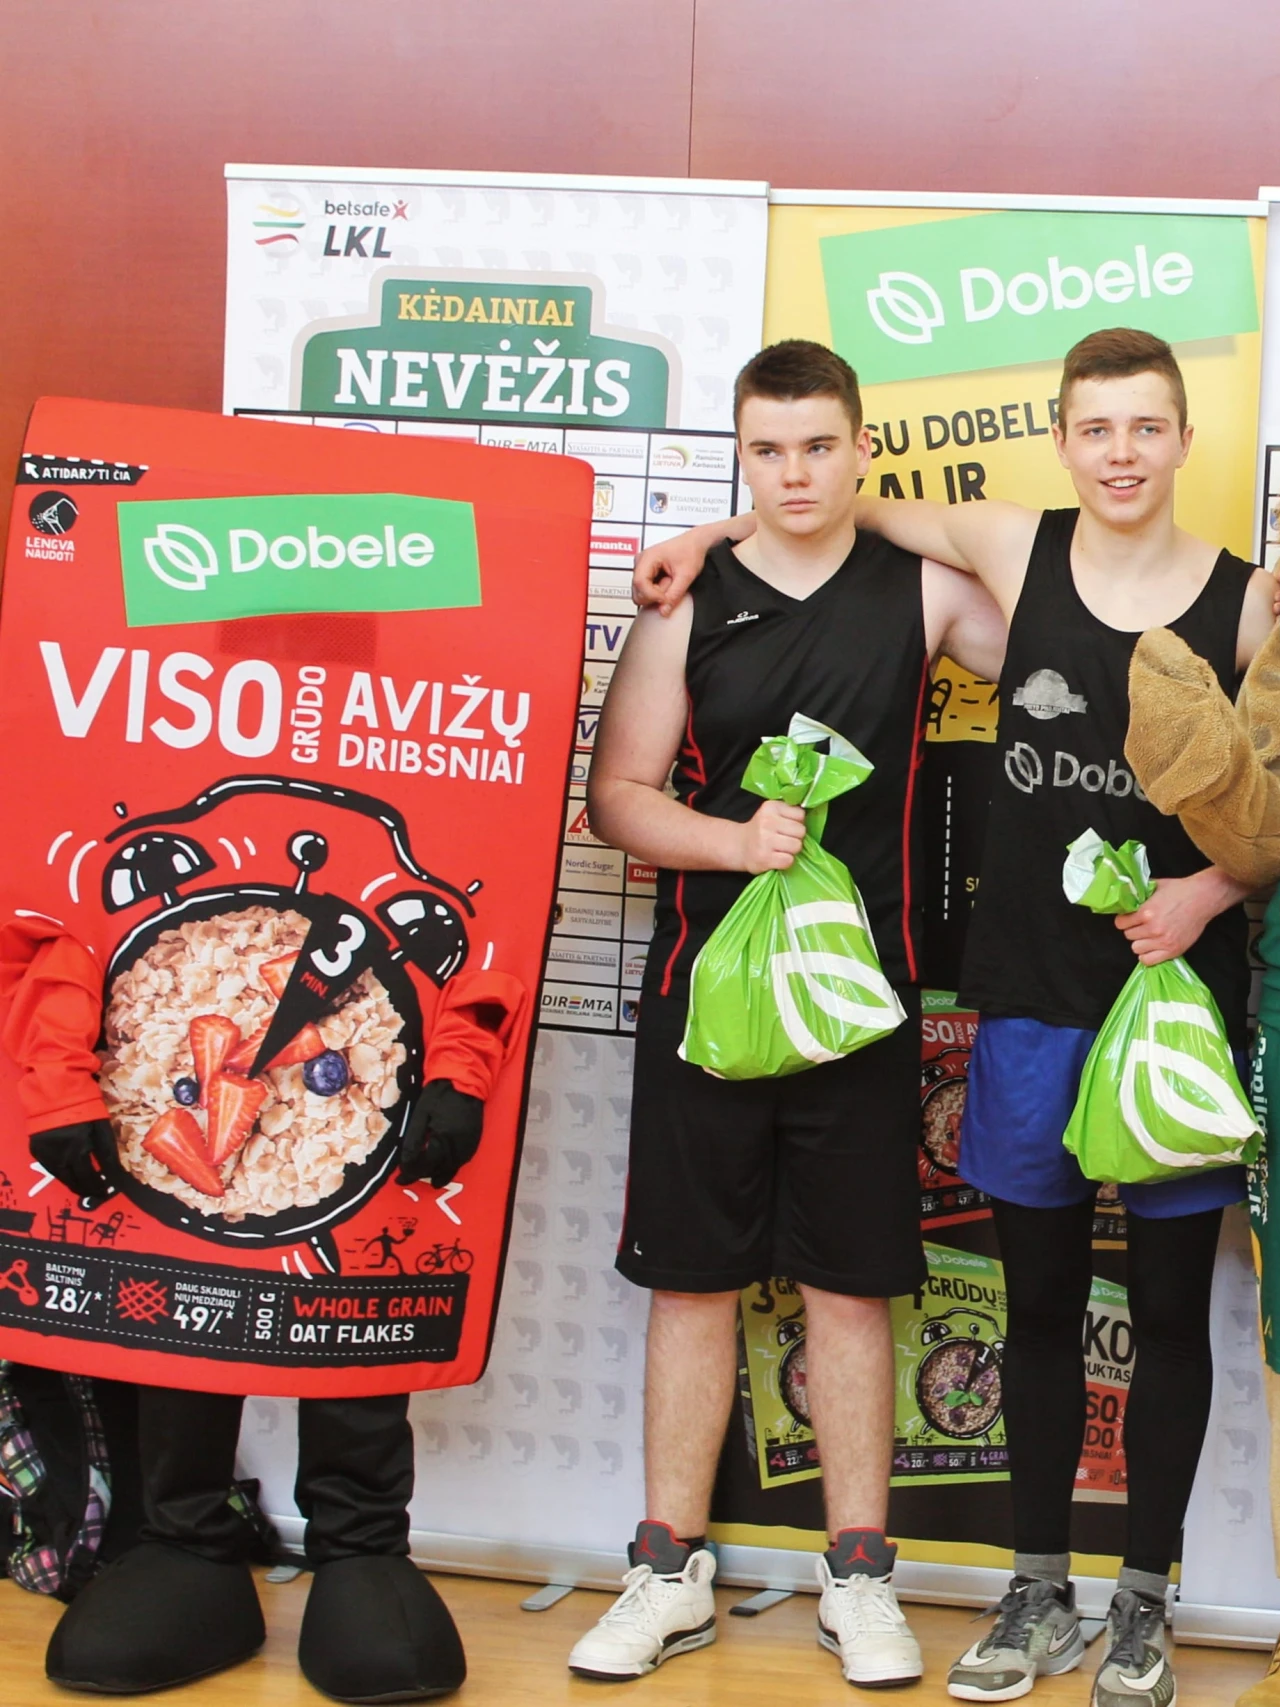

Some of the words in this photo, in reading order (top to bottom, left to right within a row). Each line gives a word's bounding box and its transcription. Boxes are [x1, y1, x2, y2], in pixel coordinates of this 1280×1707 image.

[324, 200, 390, 219] betsafe
[323, 225, 393, 259] LKL
[959, 244, 1194, 323] Dobele
[397, 288, 576, 328] KĖDAINIAI
[334, 338, 631, 418] NEVĖŽIS
[42, 467, 110, 481] ATIDARYTI
[26, 536, 76, 552] LENGVA
[228, 525, 435, 574] Dobele
[590, 540, 633, 552] mantu
[25, 548, 75, 563] NAUDOTI
[600, 587, 631, 597] PARTNER
[38, 640, 284, 759] VISO
[290, 665, 327, 765] GRŪDO
[339, 671, 531, 749] AVIŽŲ
[337, 732, 526, 785] DRIBSNIAI
[565, 859, 591, 868] Nordic
[592, 861, 615, 872] Sugar
[633, 868, 658, 879] Dau
[310, 914, 367, 978] 3
[175, 1282, 199, 1293] DAUG
[259, 1291, 276, 1302] G
[1100, 1286, 1128, 1300] Dob
[293, 1295, 380, 1319] WHOLE
[387, 1295, 453, 1318] GRAIN
[254, 1307, 275, 1341] 500
[289, 1323, 332, 1343] OAT
[336, 1322, 416, 1344] FLAKES
[1084, 1309, 1137, 1366] KO
[1084, 1361, 1131, 1384] UKTAS
